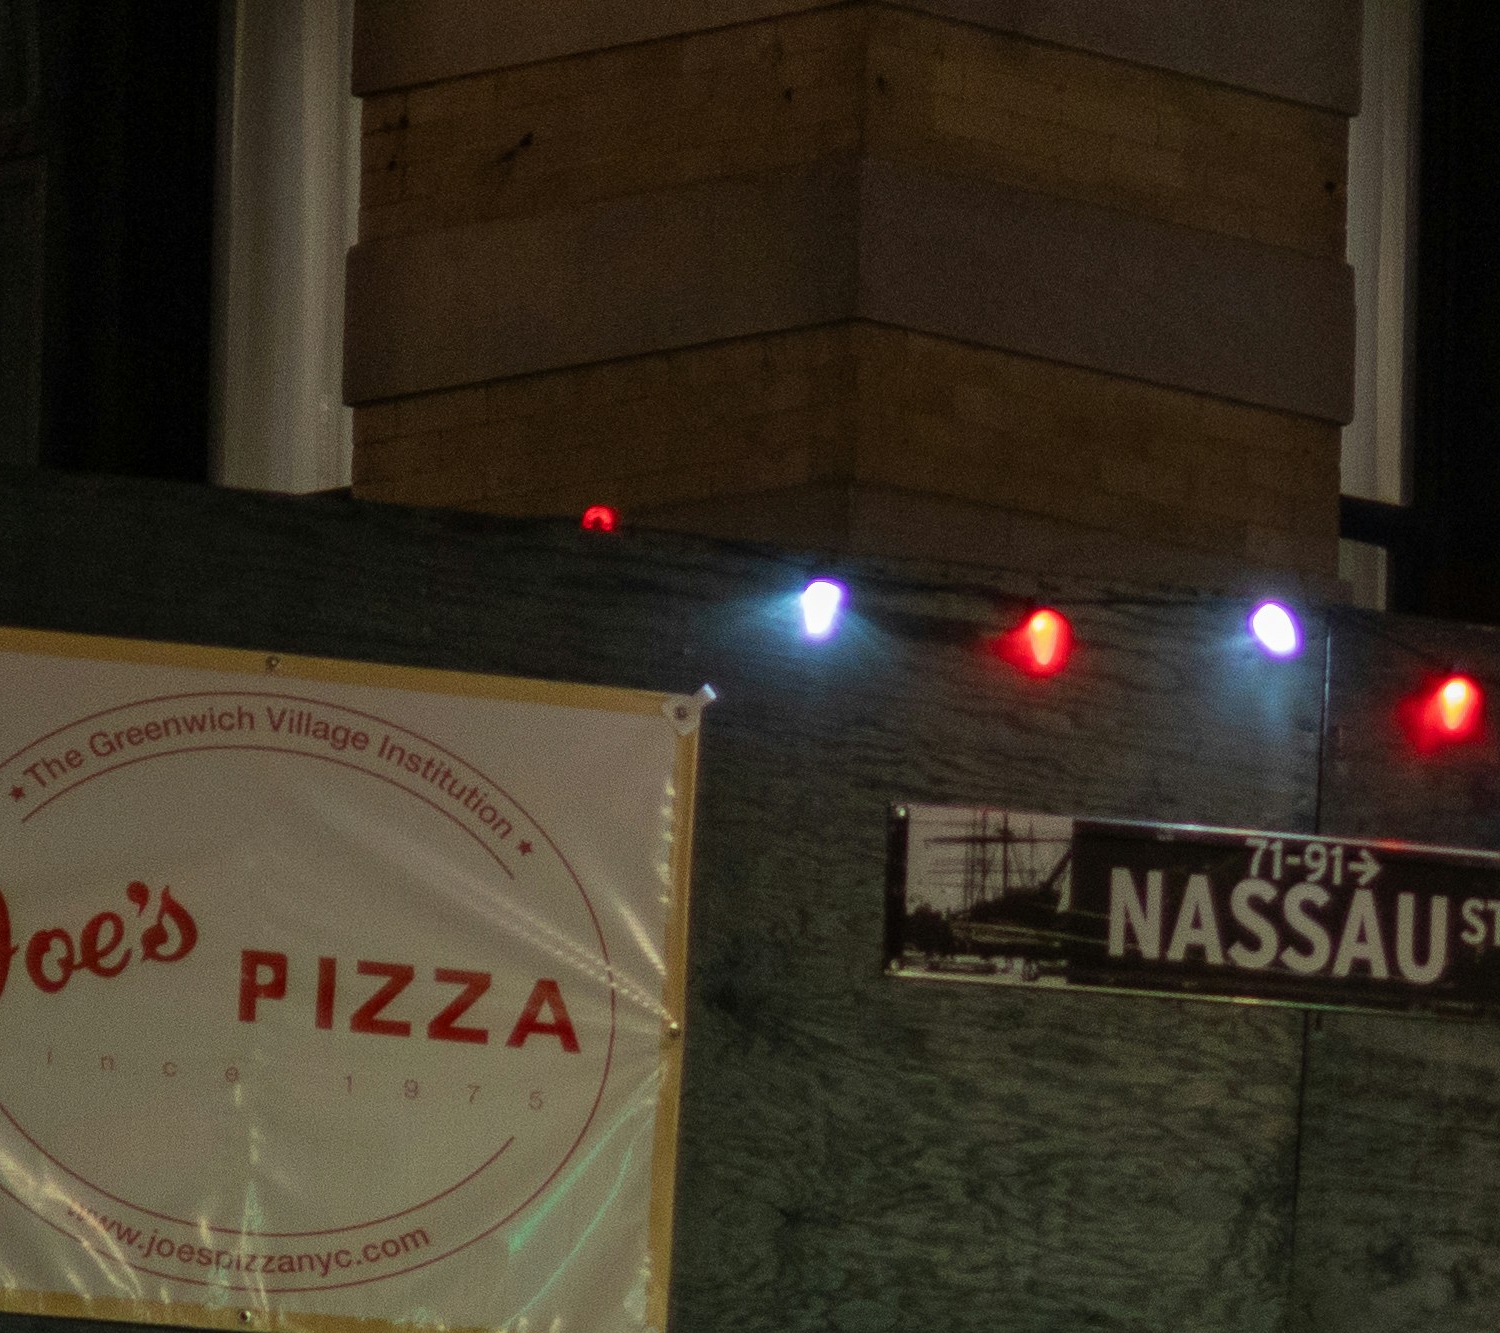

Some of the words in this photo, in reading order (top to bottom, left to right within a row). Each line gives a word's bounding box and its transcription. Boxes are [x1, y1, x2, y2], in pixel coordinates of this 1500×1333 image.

[24, 750, 85, 789] The
[90, 705, 256, 760] Greenwich
[266, 706, 369, 750] Village
[378, 735, 514, 839] Institution
[1246, 837, 1344, 887] 71-91
[1108, 868, 1448, 985] NASSAU
[237, 949, 582, 1054] PIZZA
